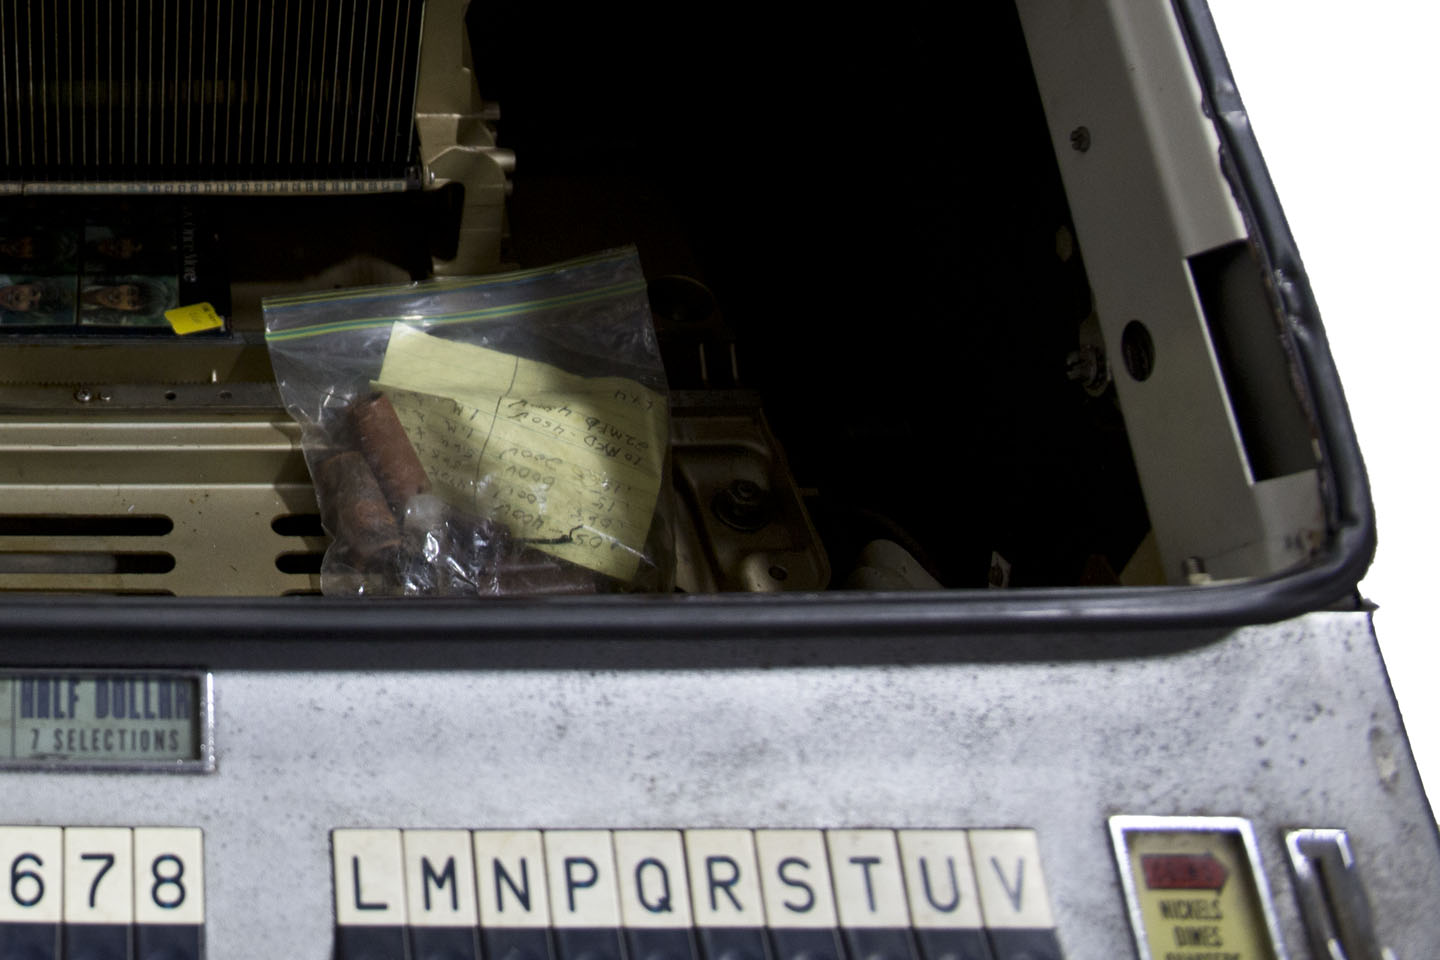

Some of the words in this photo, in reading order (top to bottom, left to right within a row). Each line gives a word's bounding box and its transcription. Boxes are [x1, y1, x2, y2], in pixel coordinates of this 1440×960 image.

[53, 728, 180, 752] SELECTIONS
[10, 853, 45, 907] 6
[80, 854, 114, 908] 7
[151, 854, 186, 908] 8
[353, 856, 388, 911] L
[422, 856, 459, 911] M
[493, 857, 532, 912] N
[566, 857, 600, 913] P
[635, 857, 673, 913] Q
[707, 856, 744, 912] R
[777, 857, 816, 913] S
[848, 857, 881, 912] T
[920, 857, 961, 913] U
[989, 857, 1025, 912] V
